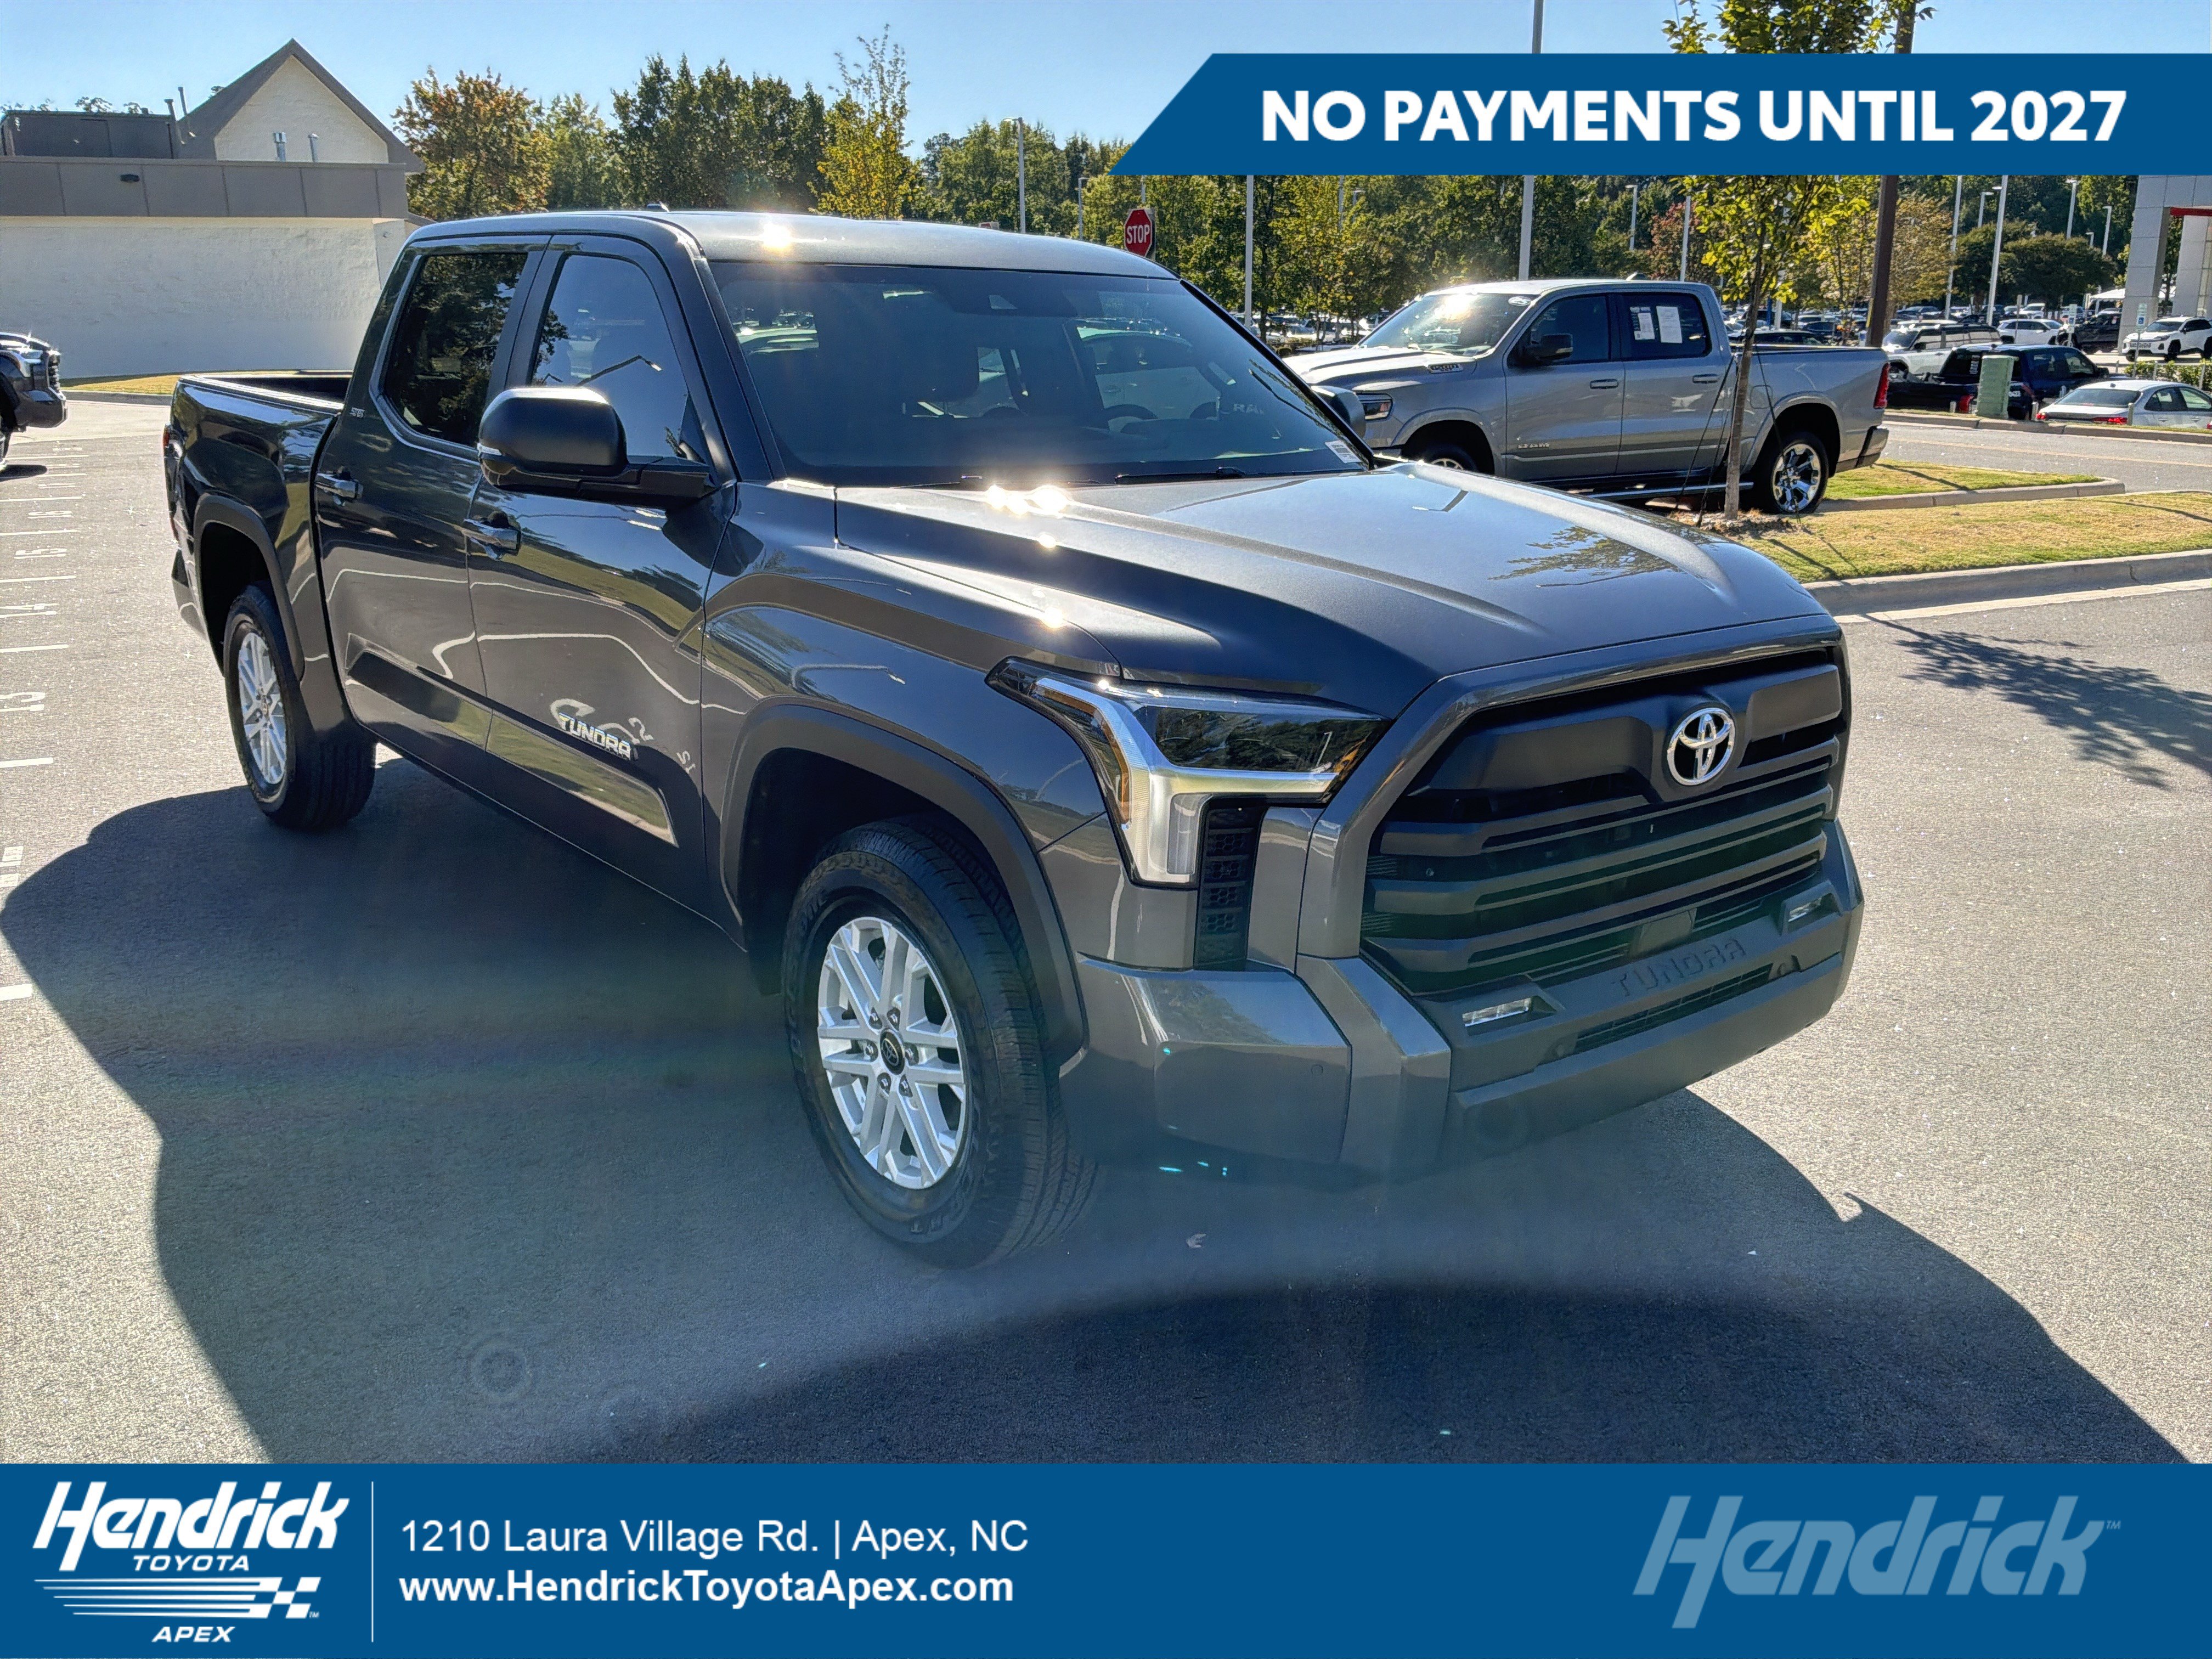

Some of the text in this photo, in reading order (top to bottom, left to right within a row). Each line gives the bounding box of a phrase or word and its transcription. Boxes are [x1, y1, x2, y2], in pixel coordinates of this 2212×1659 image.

[1127, 224, 1150, 244] STOP
[558, 712, 631, 761] TUNDRA
[1611, 938, 1746, 997] TUNDRA
